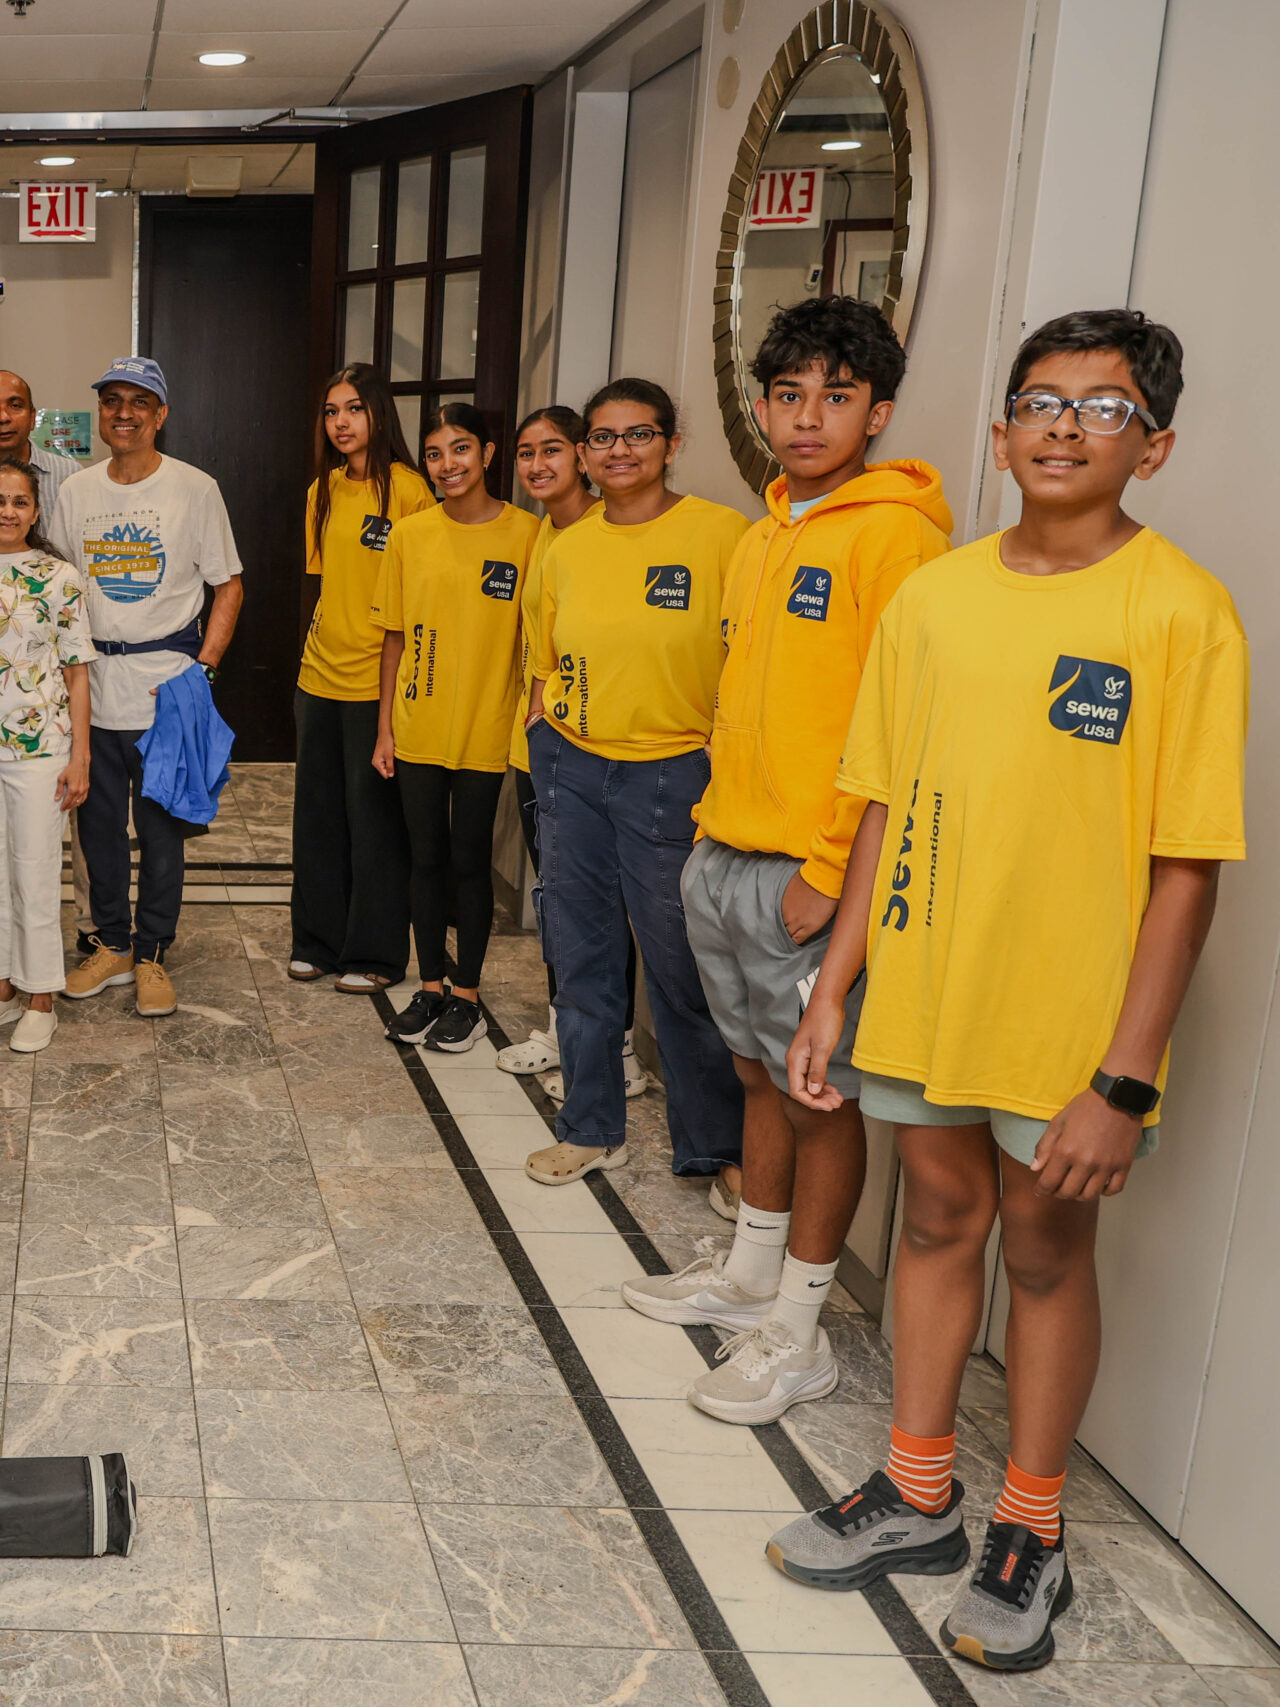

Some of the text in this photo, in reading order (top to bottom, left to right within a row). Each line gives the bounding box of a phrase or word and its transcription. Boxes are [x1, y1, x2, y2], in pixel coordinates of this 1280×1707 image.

[28, 186, 88, 227] EXIT
[51, 428, 70, 436] USE
[44, 440, 81, 448] STIRS
[104, 544, 149, 553] ORIGINAL
[95, 564, 122, 573] SINCE
[489, 580, 512, 590] sewa
[496, 591, 510, 599] usa
[654, 587, 685, 597] sewa
[666, 599, 684, 607] usa
[795, 593, 824, 606] sewa
[805, 608, 822, 618] usa
[425, 629, 437, 697] International
[554, 654, 575, 720] ewa
[577, 656, 589, 737] International
[1065, 700, 1119, 722] sewa
[1084, 723, 1115, 740] usa
[925, 792, 943, 927] International
